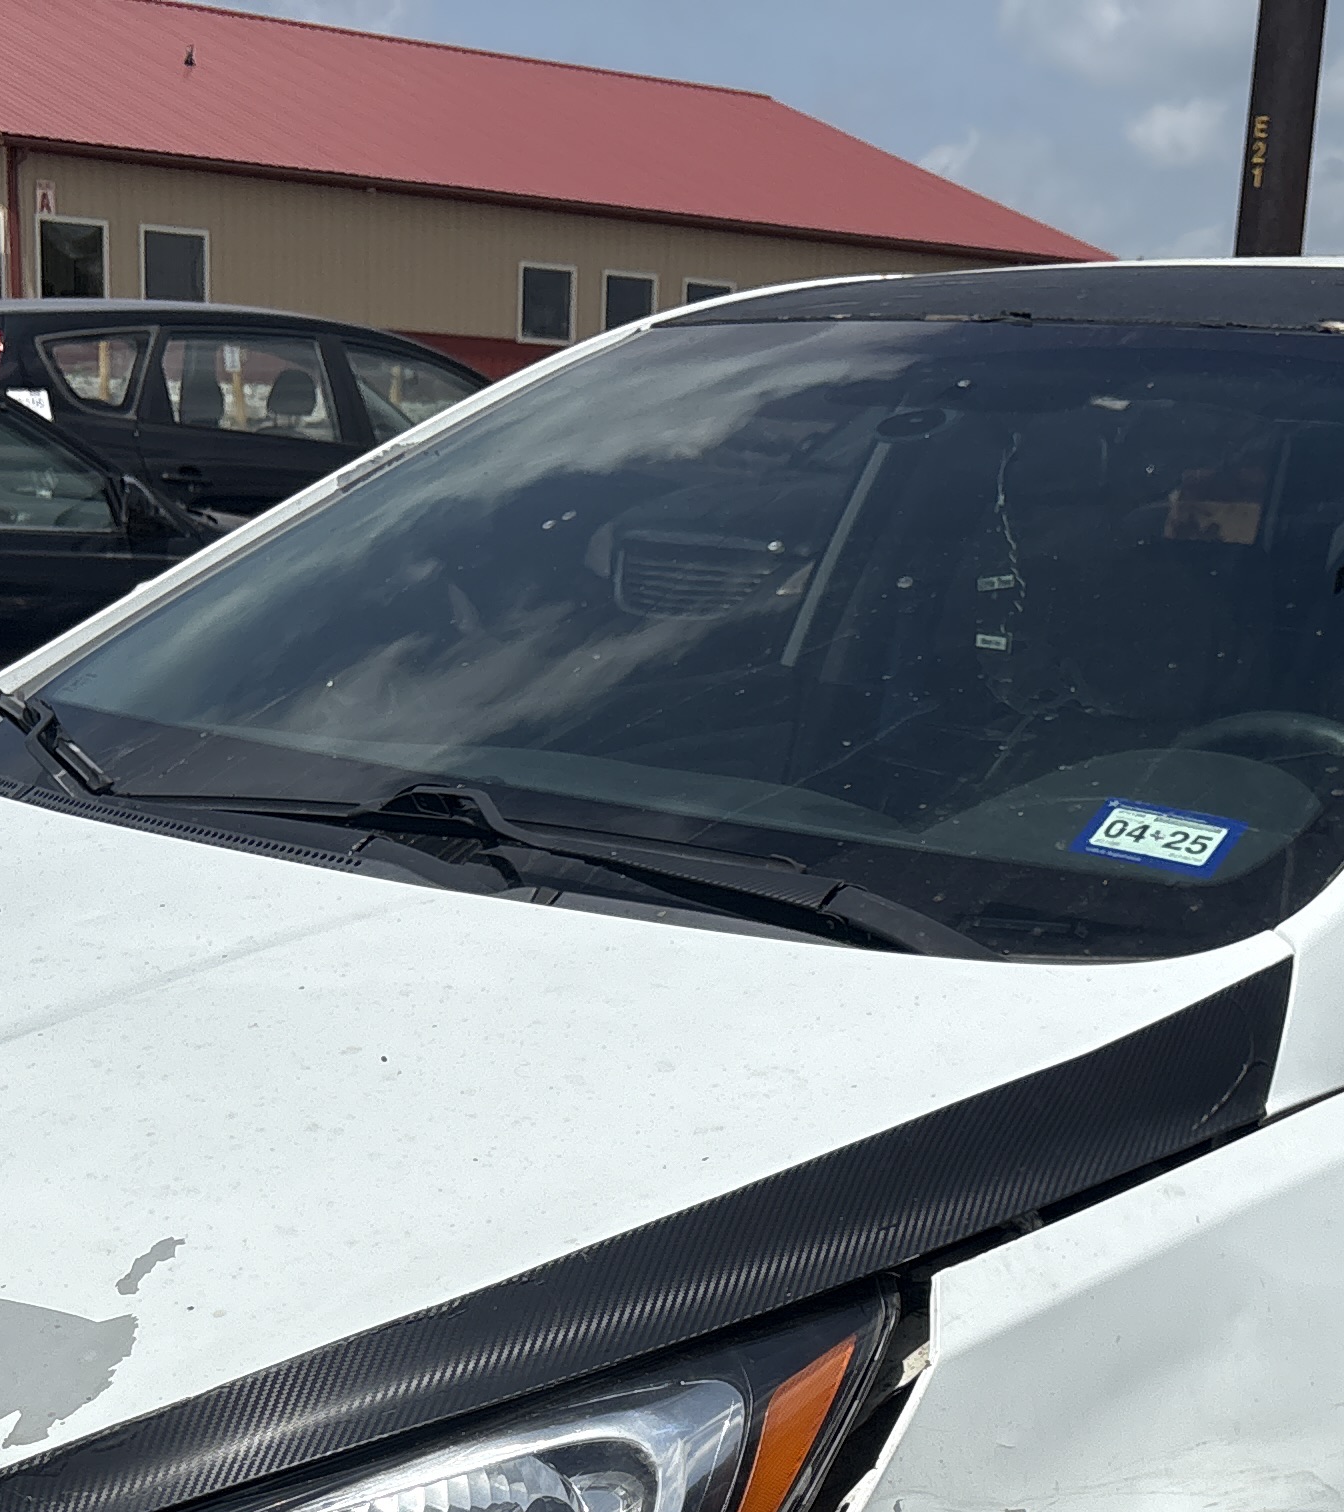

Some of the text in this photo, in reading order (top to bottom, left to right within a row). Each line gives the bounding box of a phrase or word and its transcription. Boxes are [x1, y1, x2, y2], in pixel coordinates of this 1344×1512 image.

[1250, 115, 1271, 188] E21
[1104, 819, 1151, 843] 04
[1161, 831, 1213, 855] 25
